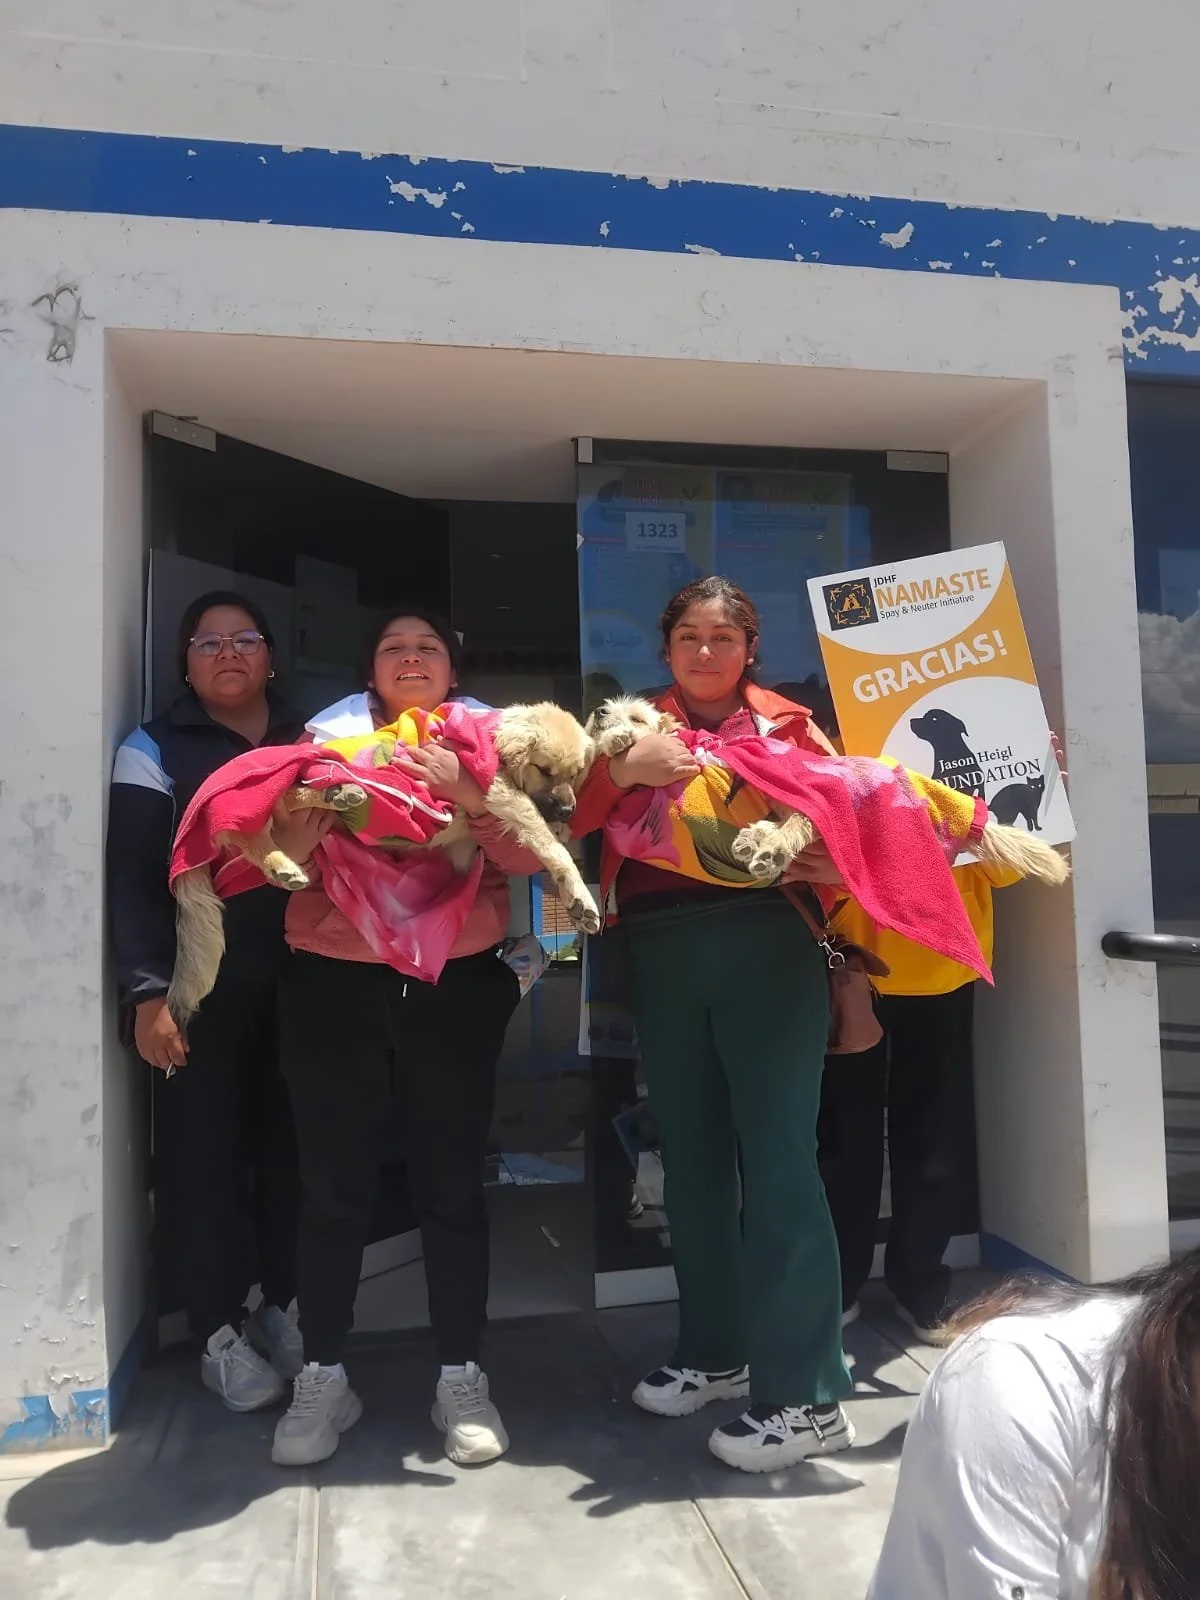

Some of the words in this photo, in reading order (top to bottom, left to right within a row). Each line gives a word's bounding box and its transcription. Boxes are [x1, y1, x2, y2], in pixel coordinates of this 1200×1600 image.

[637, 522, 678, 538] 1323
[874, 574, 897, 588] JDHF
[875, 568, 991, 609] NAMASTE
[880, 609, 900, 620] Spay
[902, 606, 909, 614] &
[910, 602, 938, 613] Neuter
[940, 594, 974, 606] Initiative
[853, 629, 1008, 703] GRACIAS!
[938, 757, 974, 773] Jason
[977, 746, 1013, 762] Heigl
[937, 758, 1041, 790] UNDATION
